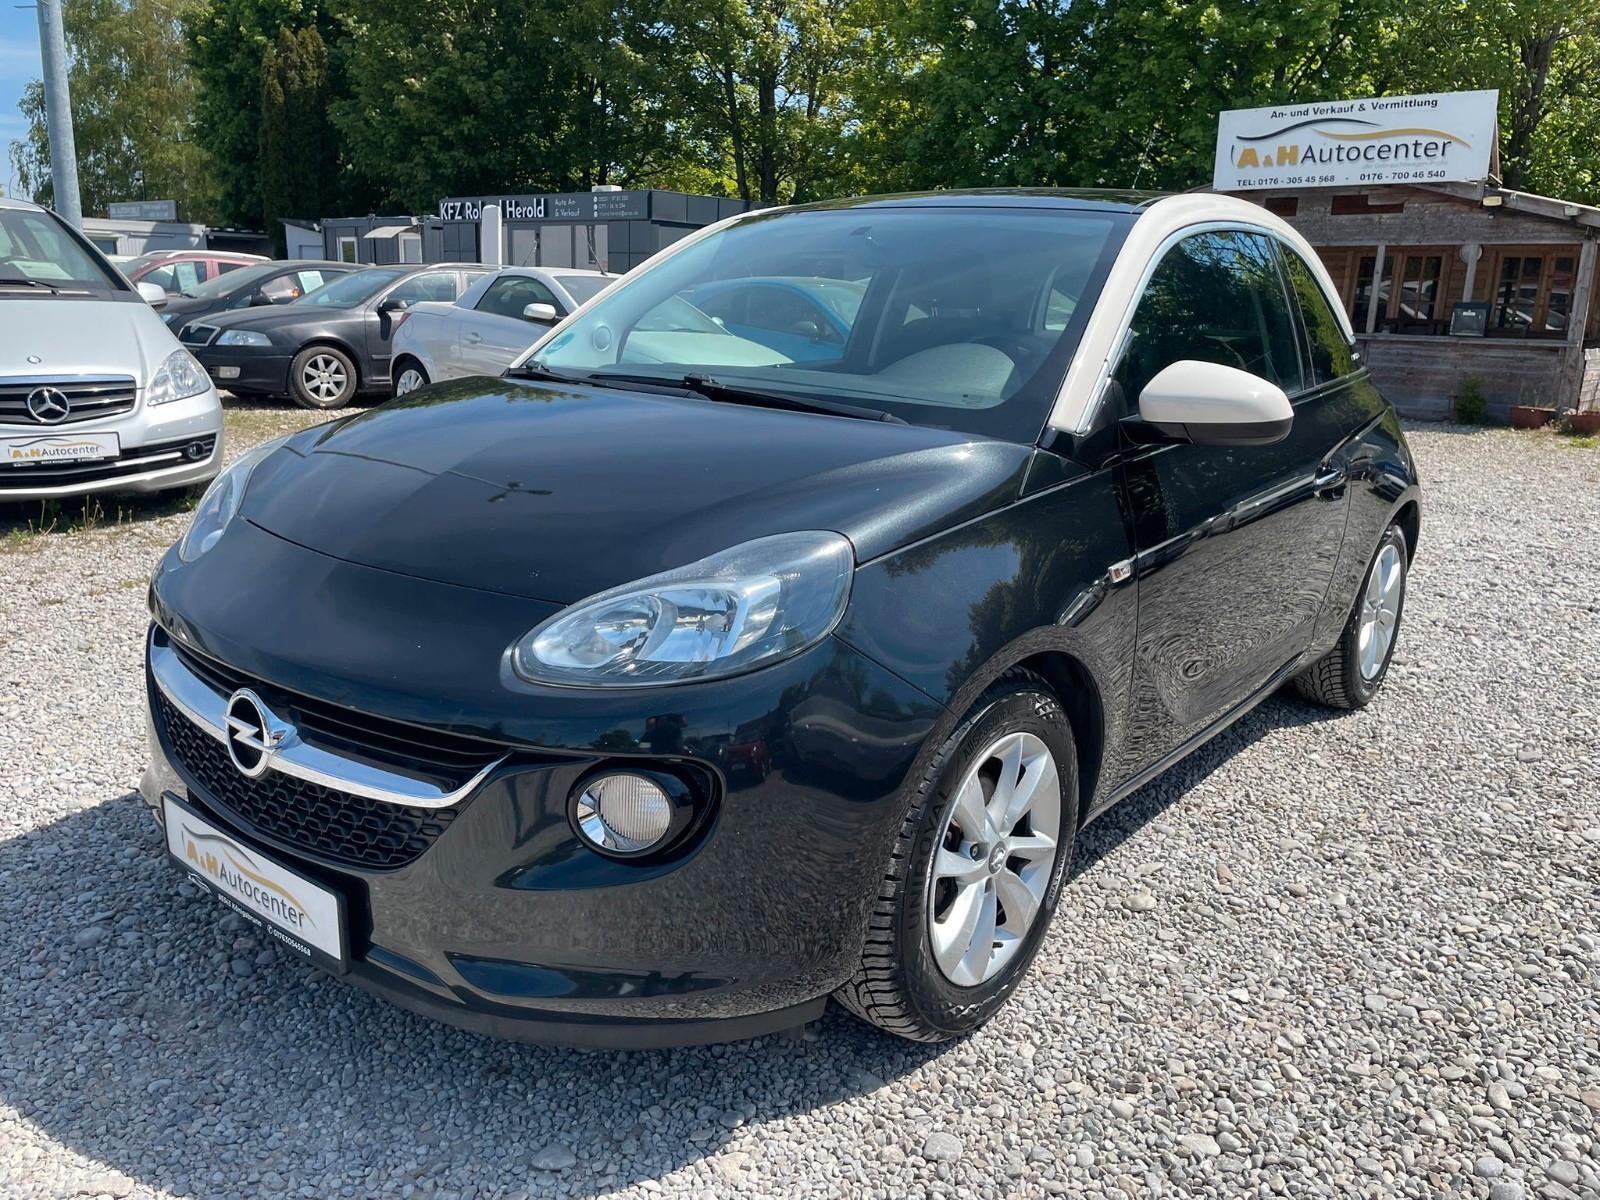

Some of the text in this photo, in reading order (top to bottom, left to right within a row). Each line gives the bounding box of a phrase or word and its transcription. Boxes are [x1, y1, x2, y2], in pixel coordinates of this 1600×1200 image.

[1270, 99, 1438, 119] An- und Verkauf & Vermittlung
[1237, 178, 1256, 187] TEL:
[1258, 177, 1279, 186] 0176
[1286, 176, 1303, 184] 305
[1304, 175, 1316, 184] 45
[1318, 174, 1335, 183] 568
[1360, 173, 1383, 181] 0176
[1392, 171, 1410, 180] 700
[1412, 171, 1424, 180] 46
[1428, 170, 1446, 179] 540
[440, 202, 462, 220] KFZ
[506, 197, 545, 219] Herold
[907, 789, 950, 930] UNIROYAL
